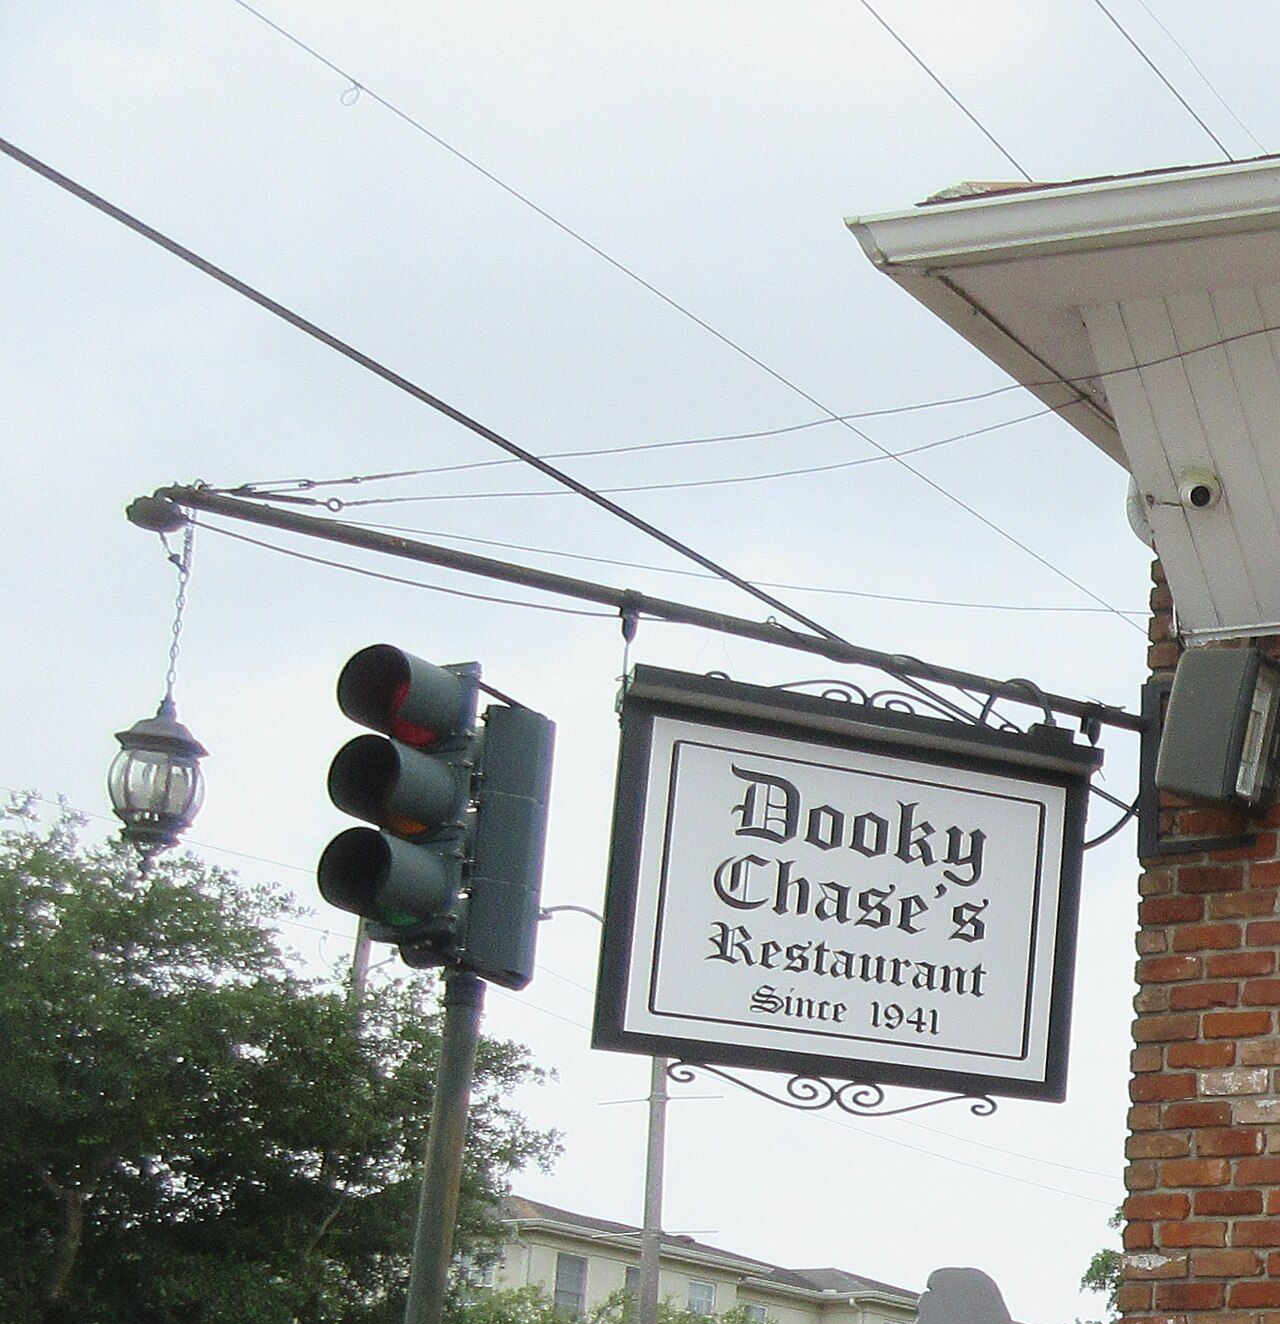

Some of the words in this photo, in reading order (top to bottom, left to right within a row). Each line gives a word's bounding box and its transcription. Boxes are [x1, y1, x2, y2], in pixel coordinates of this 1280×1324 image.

[731, 762, 987, 886] Dooky
[713, 855, 990, 943] Chase's
[704, 921, 988, 998] Restaurant
[749, 984, 848, 1023] Since
[870, 1000, 941, 1035] 1941
